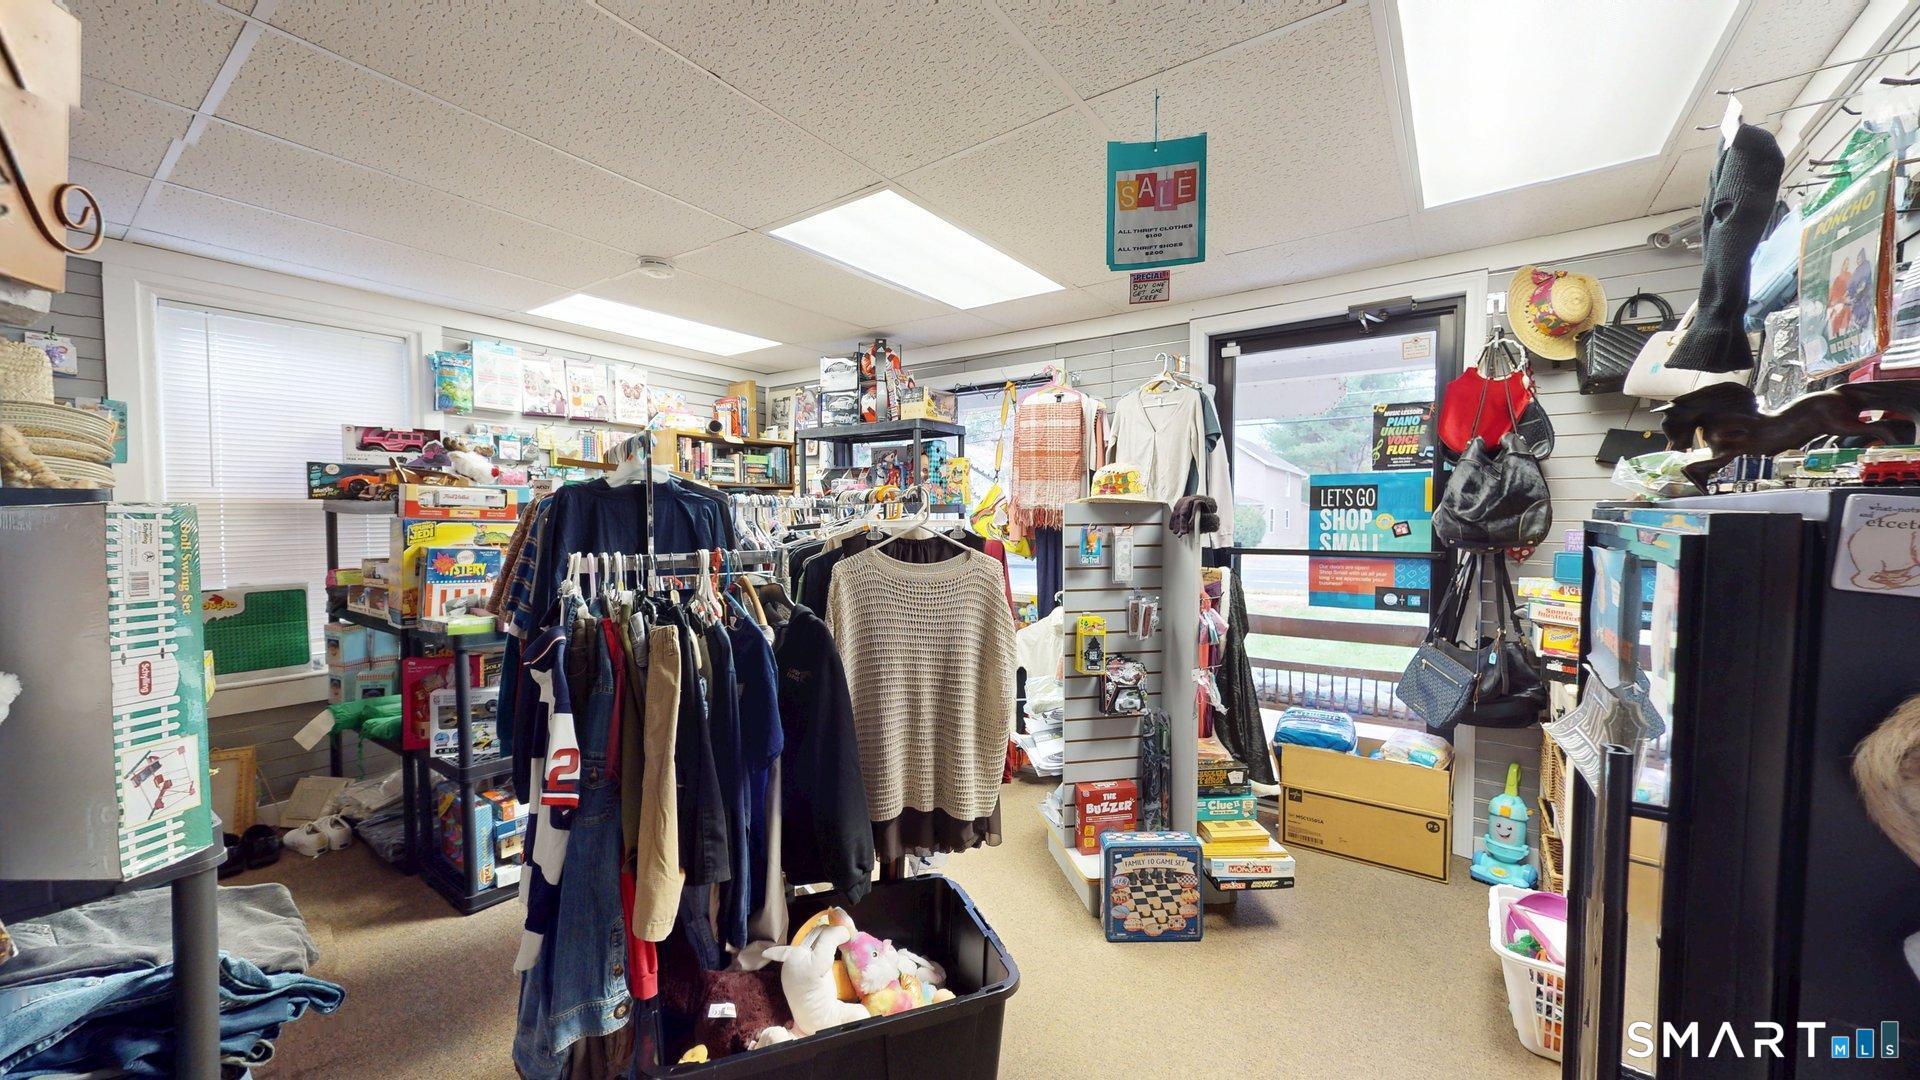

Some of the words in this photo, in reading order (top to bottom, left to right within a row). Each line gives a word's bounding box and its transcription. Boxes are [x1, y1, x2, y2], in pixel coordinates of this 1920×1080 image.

[1121, 175, 1192, 208] SALE
[1815, 190, 1877, 239] PONCHO
[1159, 223, 1193, 232] CLOTHES
[1159, 241, 1184, 249] SHOES
[1133, 283, 1148, 291] BUY
[1152, 281, 1167, 289] ONE
[1132, 289, 1147, 297] GET
[1138, 294, 1159, 302] FREE
[1400, 408, 1424, 416] LESSONS
[1386, 415, 1421, 427] PIANO
[1380, 424, 1427, 437] UKULELE
[1387, 435, 1420, 446] VOICE
[1386, 444, 1419, 455] FLUTE
[1320, 487, 1354, 508] LET'S
[1356, 487, 1376, 507] GO
[1319, 508, 1373, 532] SHOP
[1866, 519, 1920, 530] etcet
[409, 528, 434, 540] JEDI
[1319, 533, 1380, 551] SMALL
[178, 554, 192, 594] Swing
[446, 563, 487, 577] YSTERY
[182, 597, 193, 616] Set
[202, 600, 238, 611] duplo
[1545, 608, 1573, 616] Sports
[1550, 632, 1573, 641] Snapple
[140, 662, 151, 694] Schylling
[546, 747, 581, 792] 2
[1103, 793, 1117, 801] THE
[1207, 800, 1234, 811] Clue
[1124, 860, 1145, 868] FAMILY
[1155, 858, 1174, 866] GAME
[1175, 859, 1187, 867] SET
[1229, 865, 1272, 874] MONPOLY
